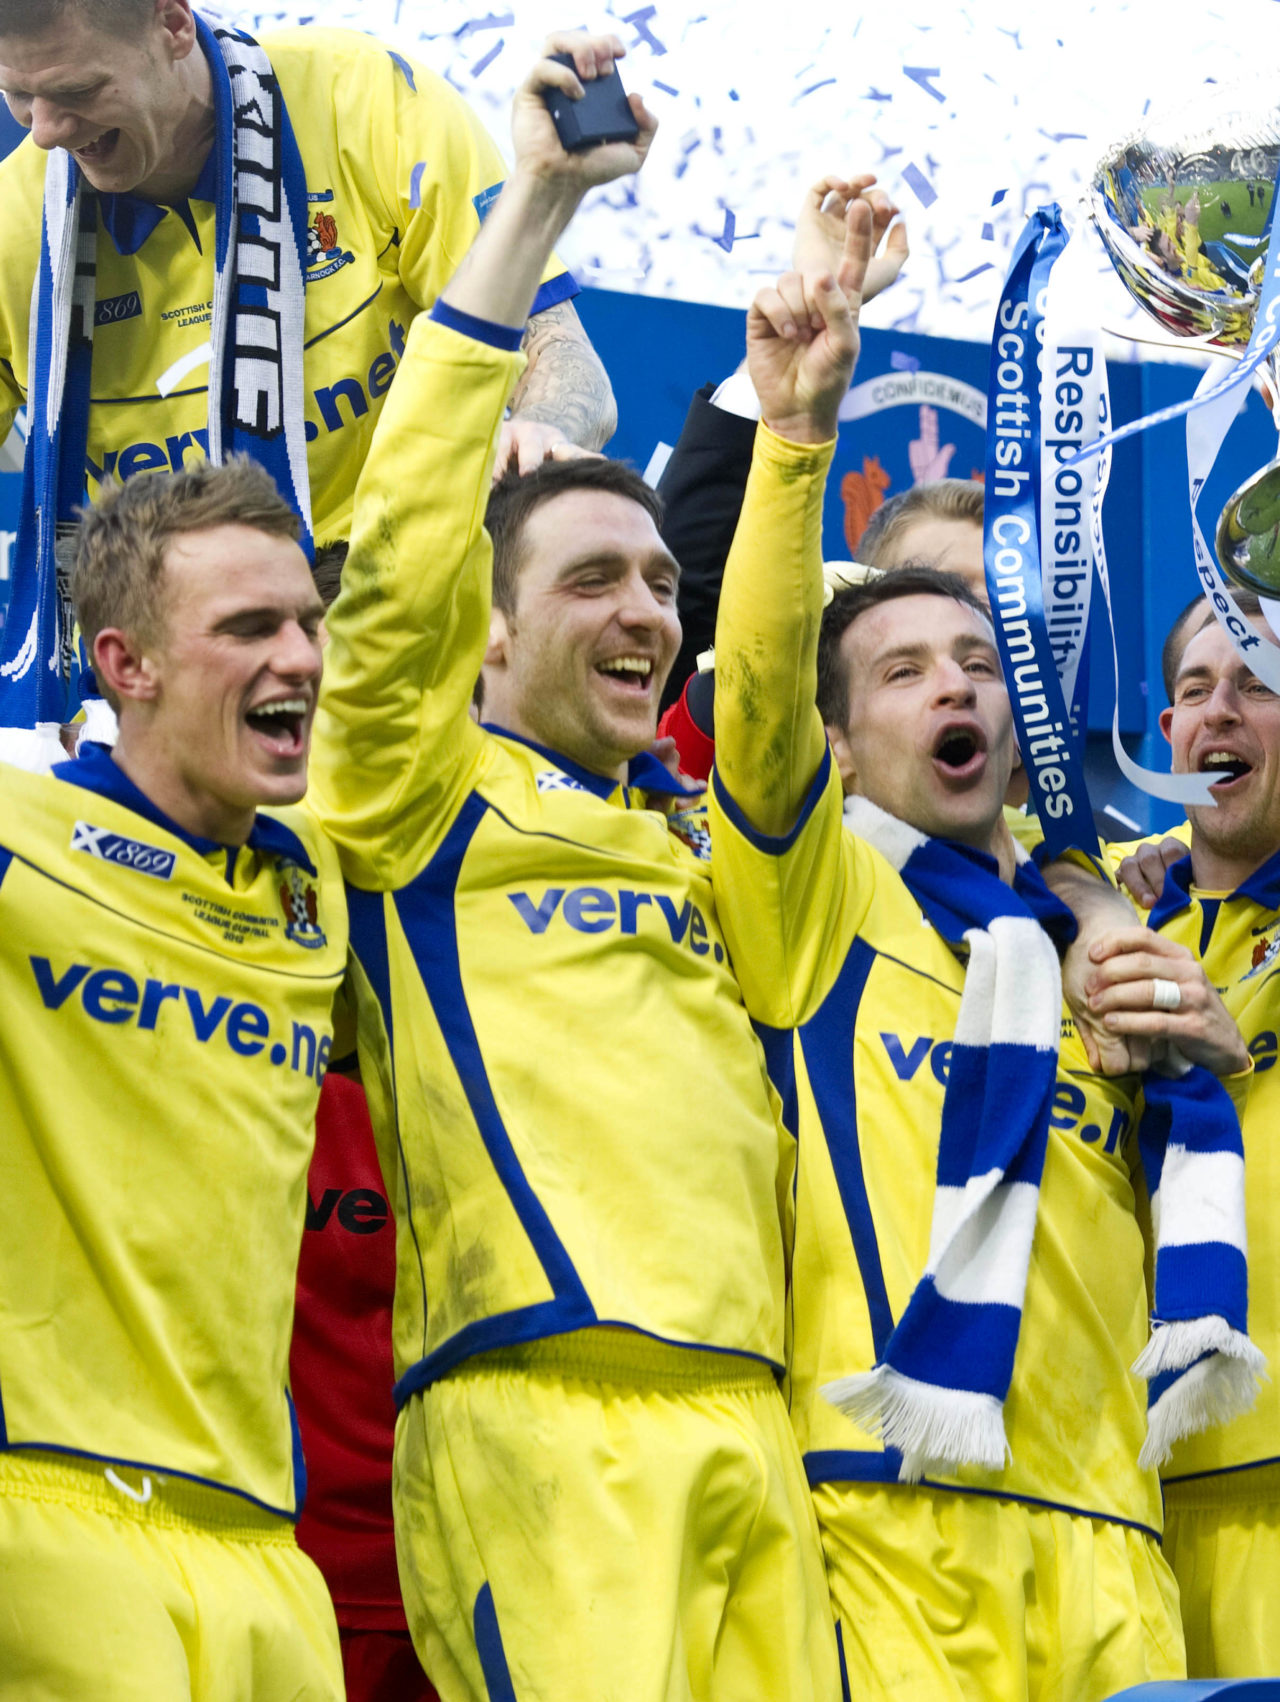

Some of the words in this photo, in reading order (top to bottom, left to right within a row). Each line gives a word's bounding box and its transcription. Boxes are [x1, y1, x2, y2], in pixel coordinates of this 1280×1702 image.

[306, 265, 336, 281] ARNOCK
[98, 294, 138, 322] 869
[161, 304, 205, 321] SCOTTISH
[177, 312, 213, 328] LEAGUE
[994, 299, 1032, 498] Scottish
[992, 514, 1074, 820] Communities
[104, 840, 171, 875] 1869
[29, 954, 334, 1088] verve.ne
